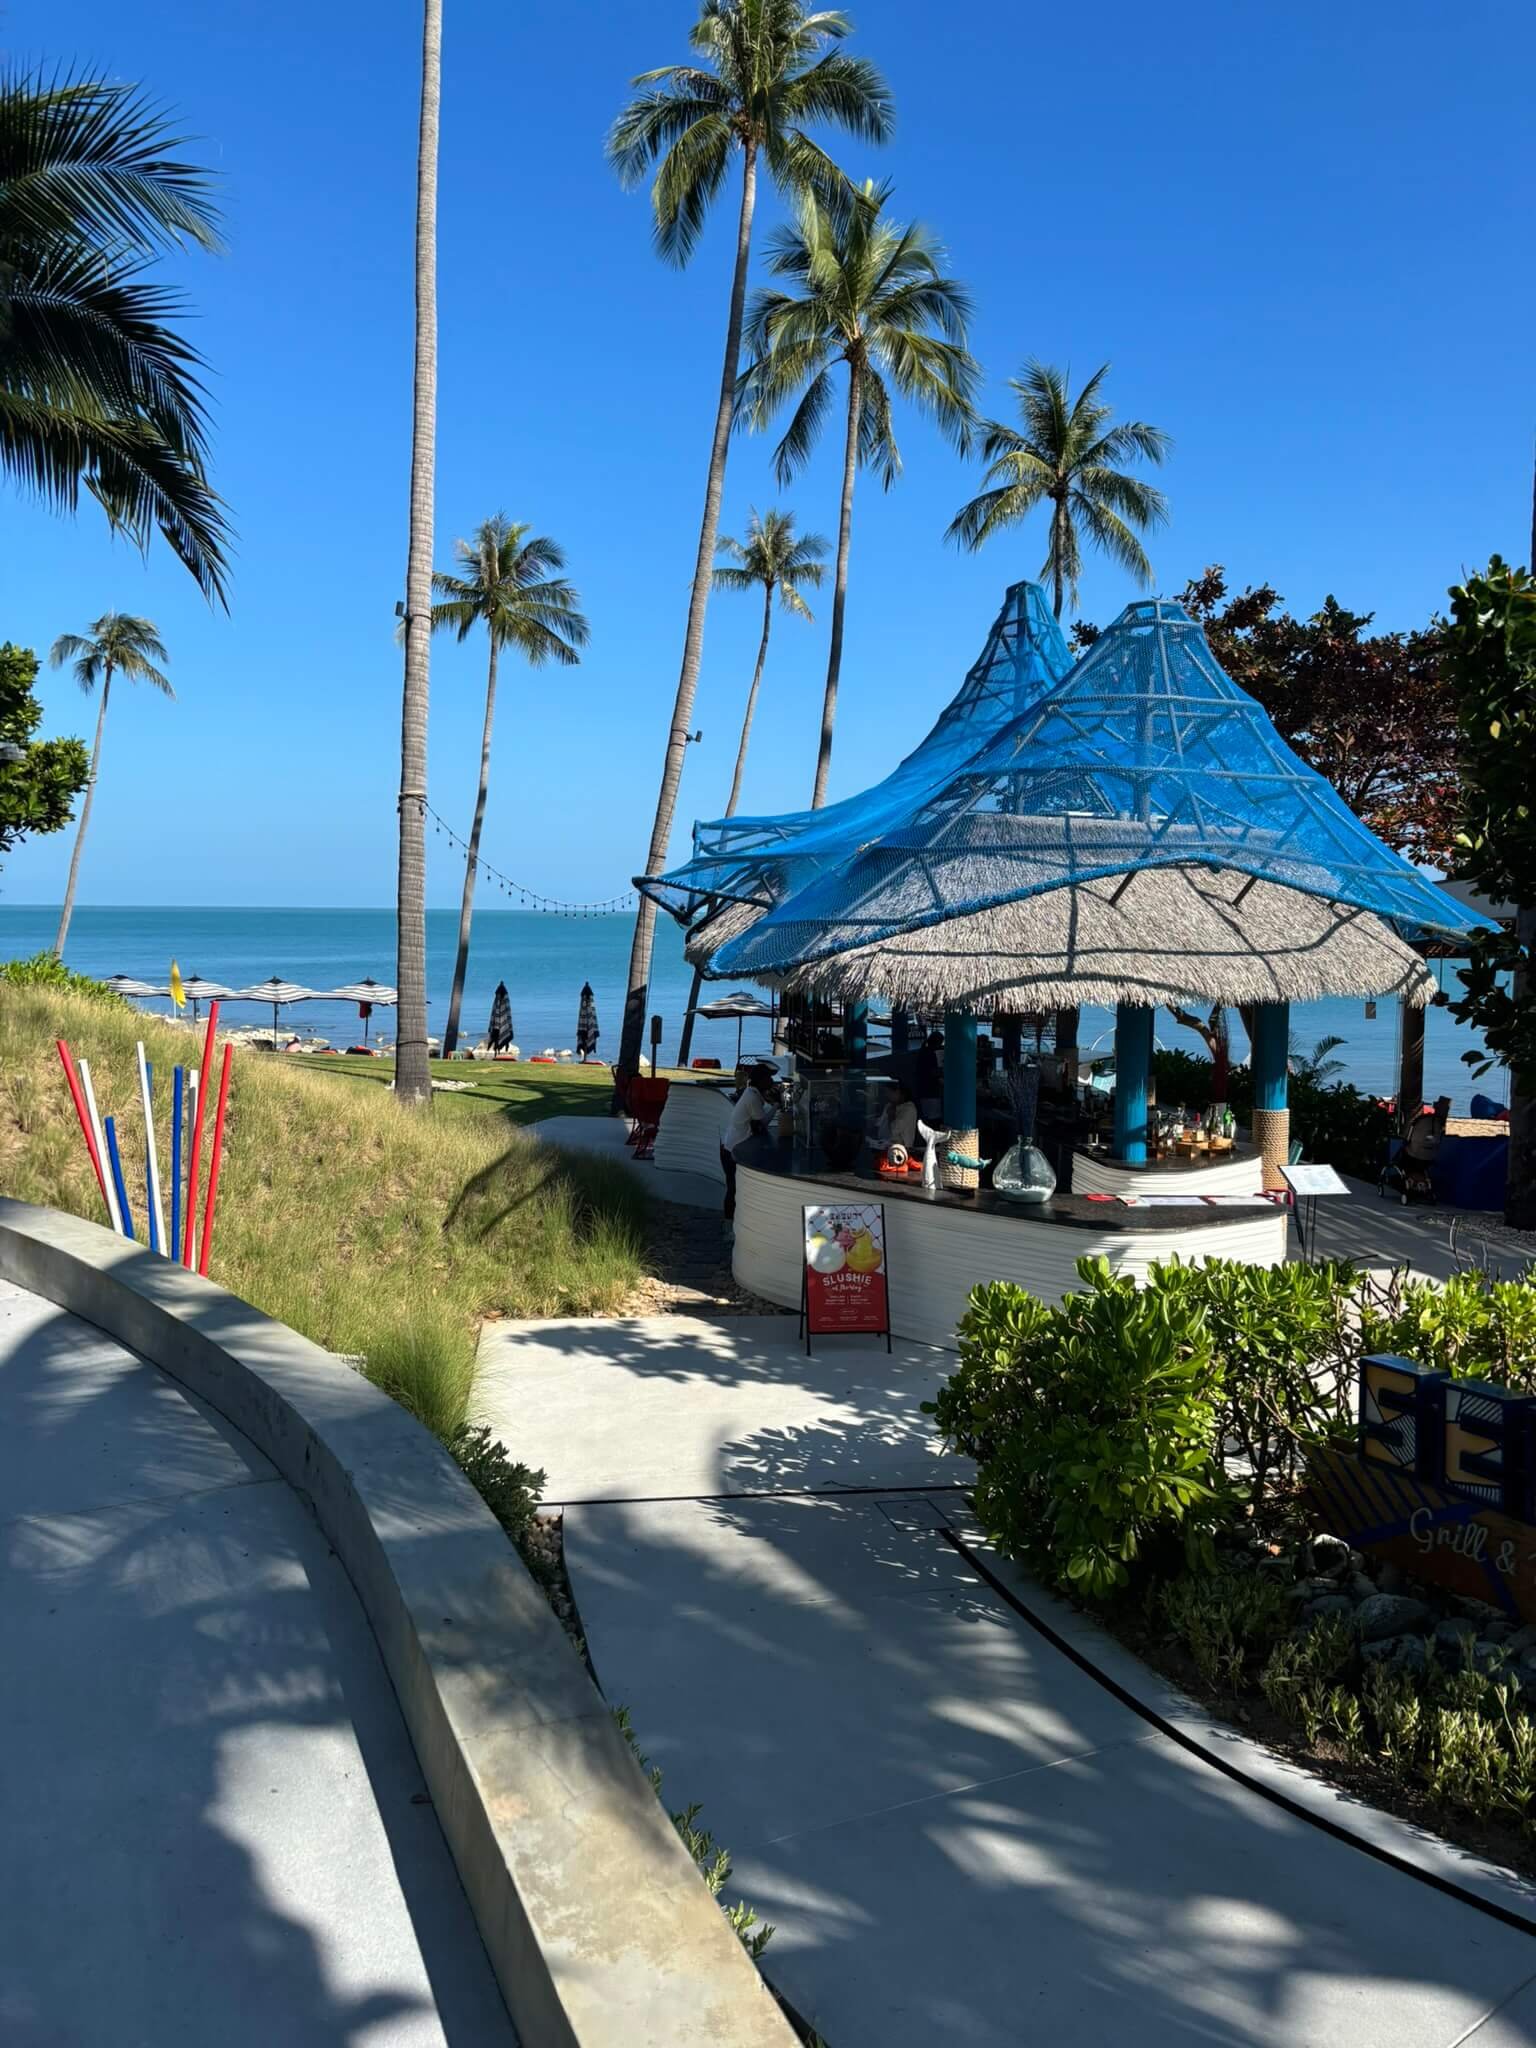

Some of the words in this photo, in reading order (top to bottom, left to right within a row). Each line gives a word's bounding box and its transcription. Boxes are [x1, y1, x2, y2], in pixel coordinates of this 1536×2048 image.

[822, 1272, 873, 1287] SLUSHIE
[1360, 1355, 1536, 1512] SE
[1410, 1507, 1489, 1563] Grill
[1495, 1539, 1518, 1576] &
